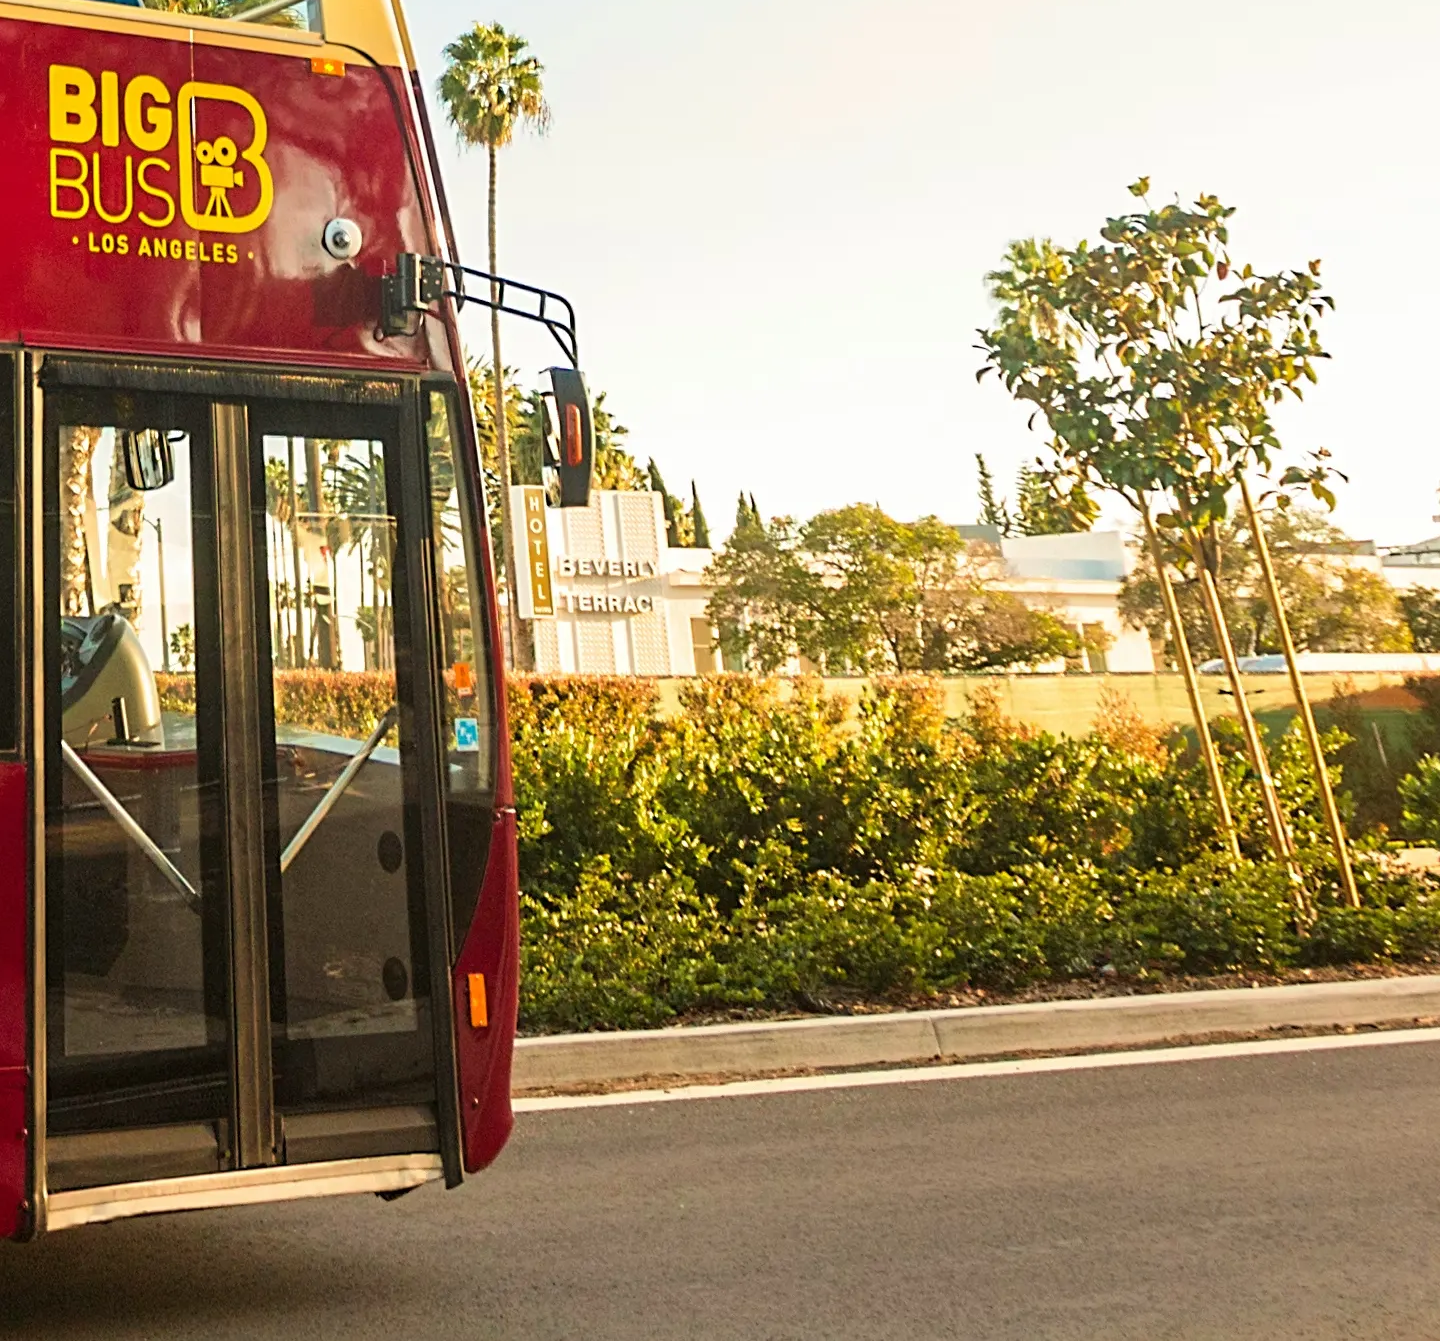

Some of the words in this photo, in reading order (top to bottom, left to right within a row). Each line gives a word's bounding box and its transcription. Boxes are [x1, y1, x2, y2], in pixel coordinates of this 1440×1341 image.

[48, 64, 173, 152] BIG
[49, 147, 176, 228] BUS
[88, 232, 129, 255] LOS
[138, 236, 239, 264] ANGELES
[528, 496, 546, 600] HOTEL
[559, 558, 660, 577] BEVERLY
[564, 589, 661, 613] TERRACE
